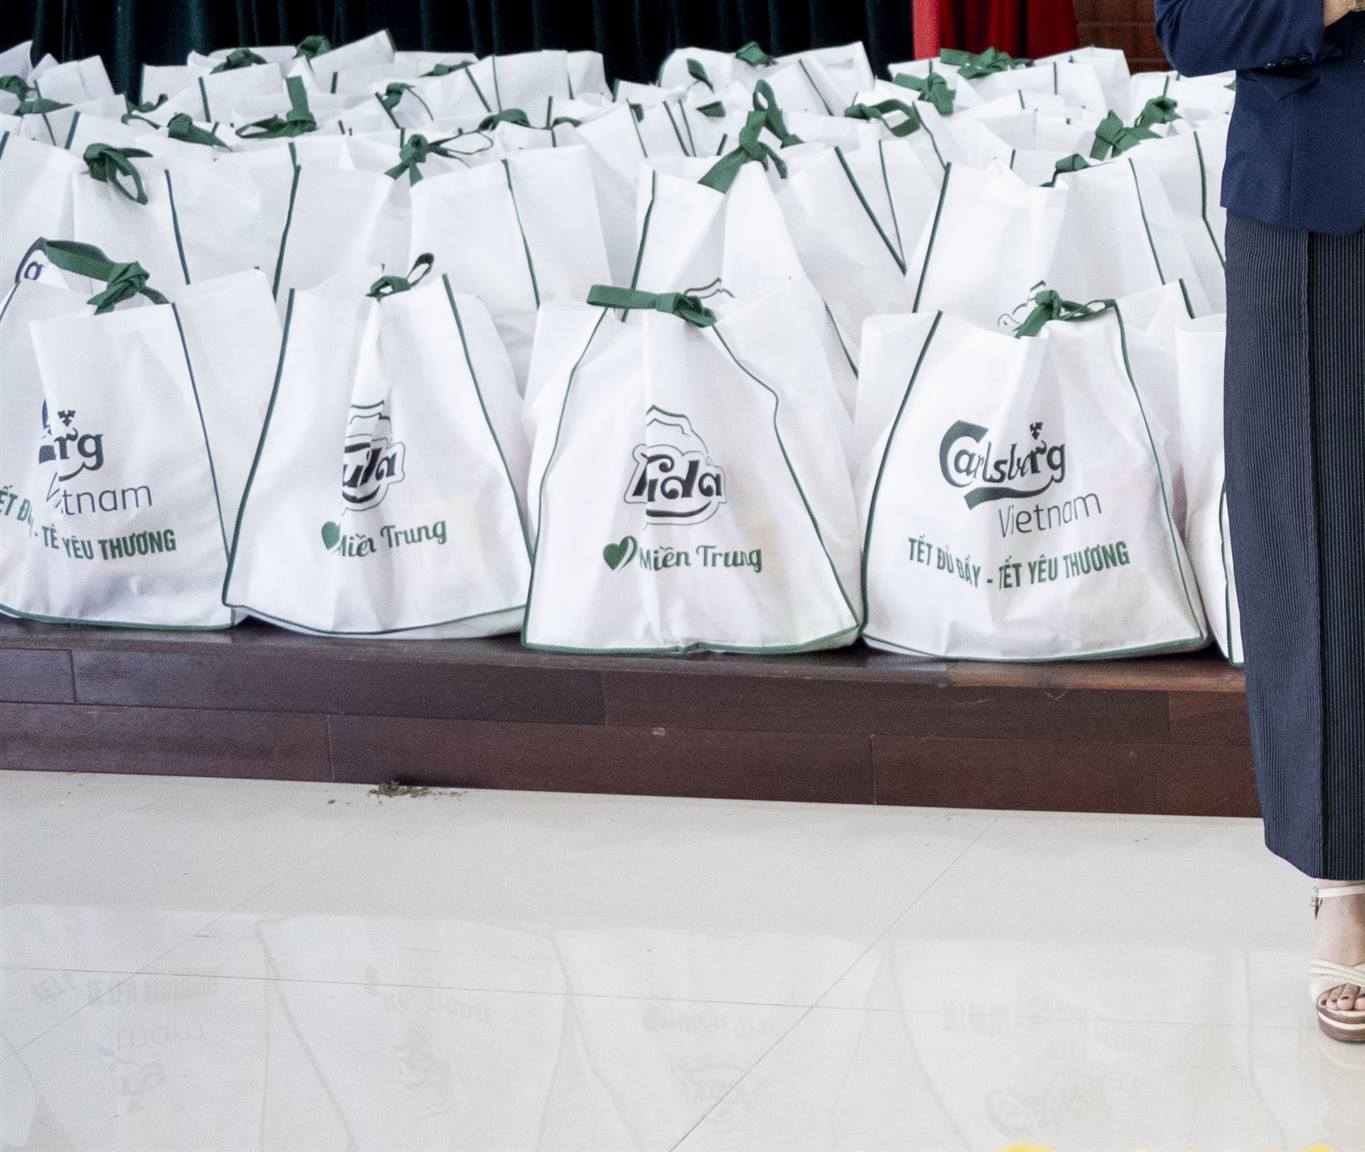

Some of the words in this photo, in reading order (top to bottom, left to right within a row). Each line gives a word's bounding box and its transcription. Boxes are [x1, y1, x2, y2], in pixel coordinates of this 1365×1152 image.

[47, 471, 153, 516] tnam
[380, 519, 448, 549] Trung
[998, 492, 1102, 538] Vietnam
[62, 535, 94, 560] YÊU
[98, 529, 178, 560] THƯƠNG
[695, 544, 764, 574] Trung
[908, 533, 934, 567] TẾT
[998, 554, 1023, 590] TẾT
[1027, 553, 1059, 585] YÊU
[1063, 540, 1131, 579] THƯƠNG
